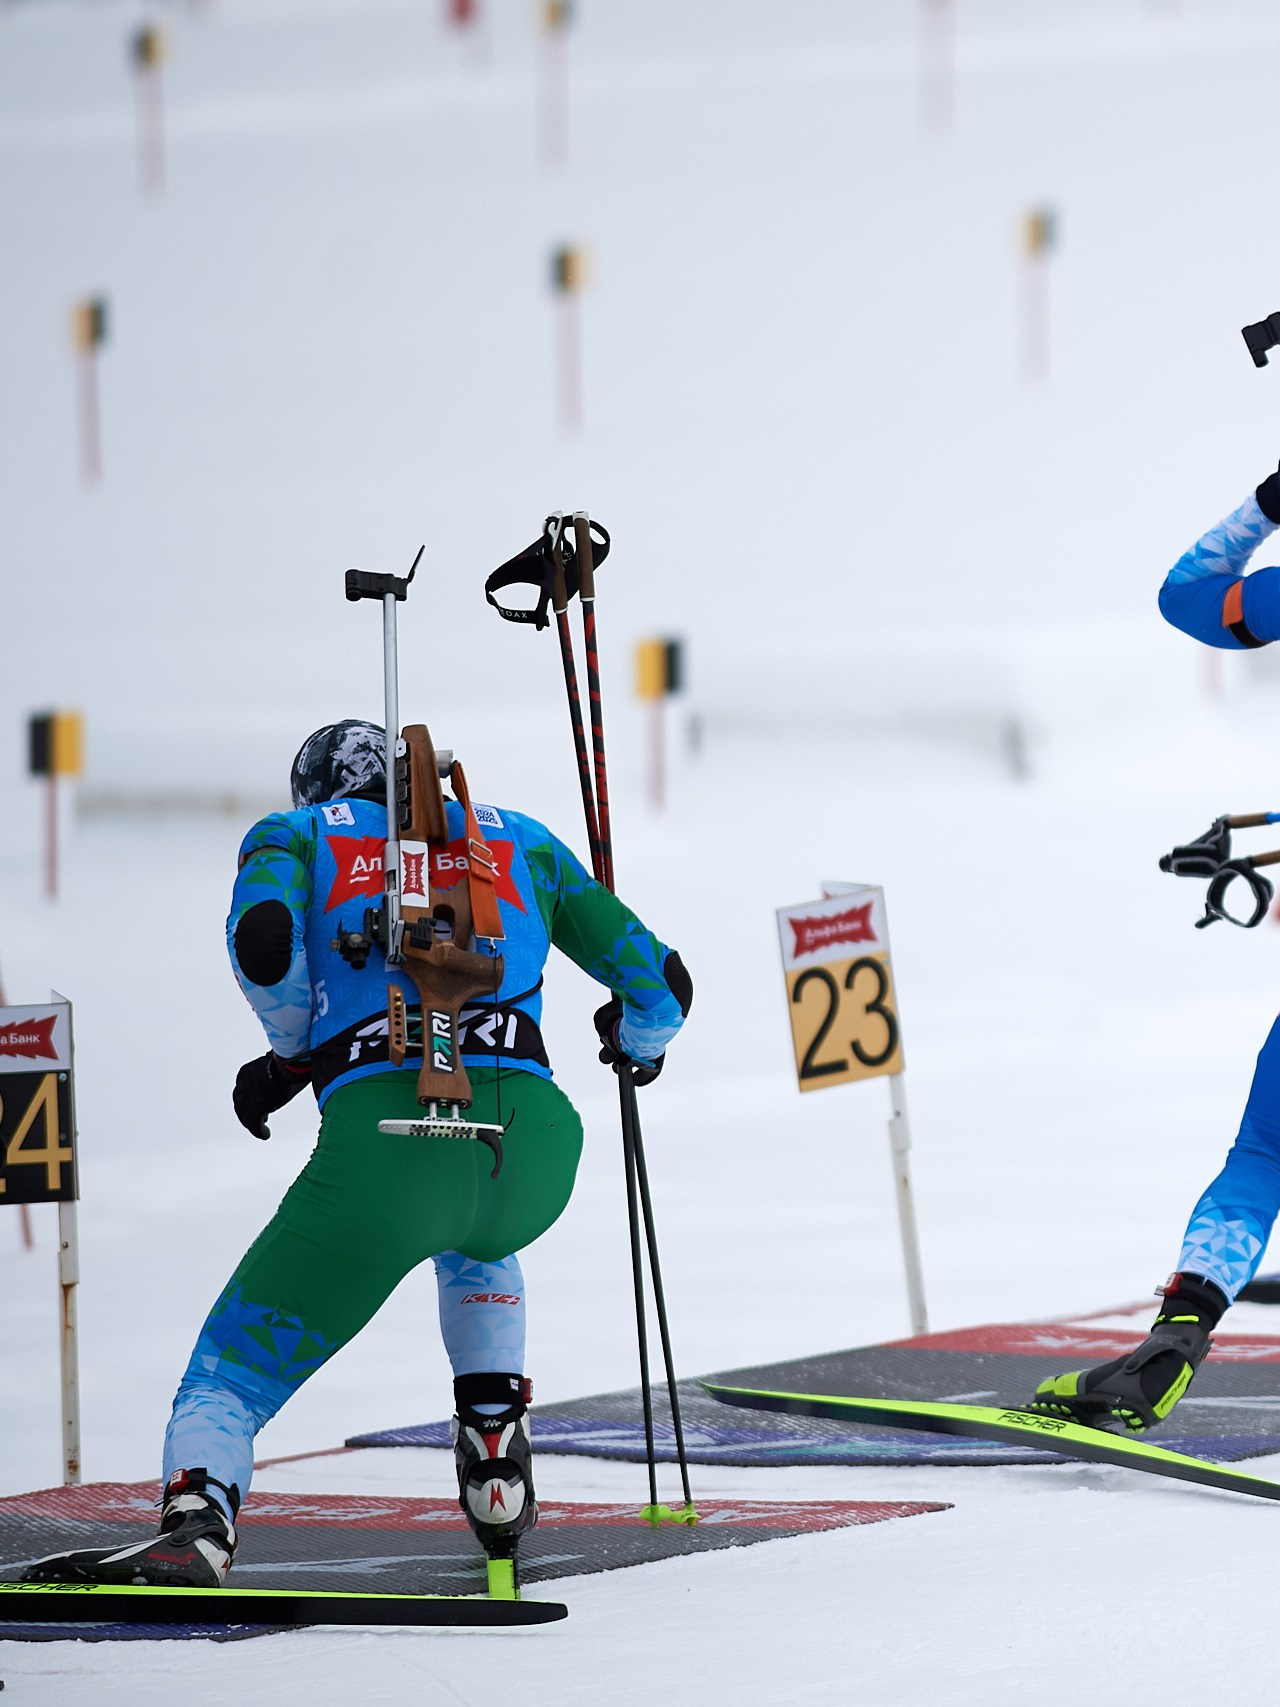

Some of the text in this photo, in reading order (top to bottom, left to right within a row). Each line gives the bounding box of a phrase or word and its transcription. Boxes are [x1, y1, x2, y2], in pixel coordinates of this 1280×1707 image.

[312, 980, 329, 1024] 5
[793, 956, 898, 1080] 23
[9, 1033, 40, 1044] Банк
[349, 1009, 518, 1062] PRI
[431, 1011, 453, 1072] PARI
[0, 1073, 72, 1193] 4
[998, 1411, 1067, 1432] FISCHER
[0, 1583, 98, 1591] SCHER
